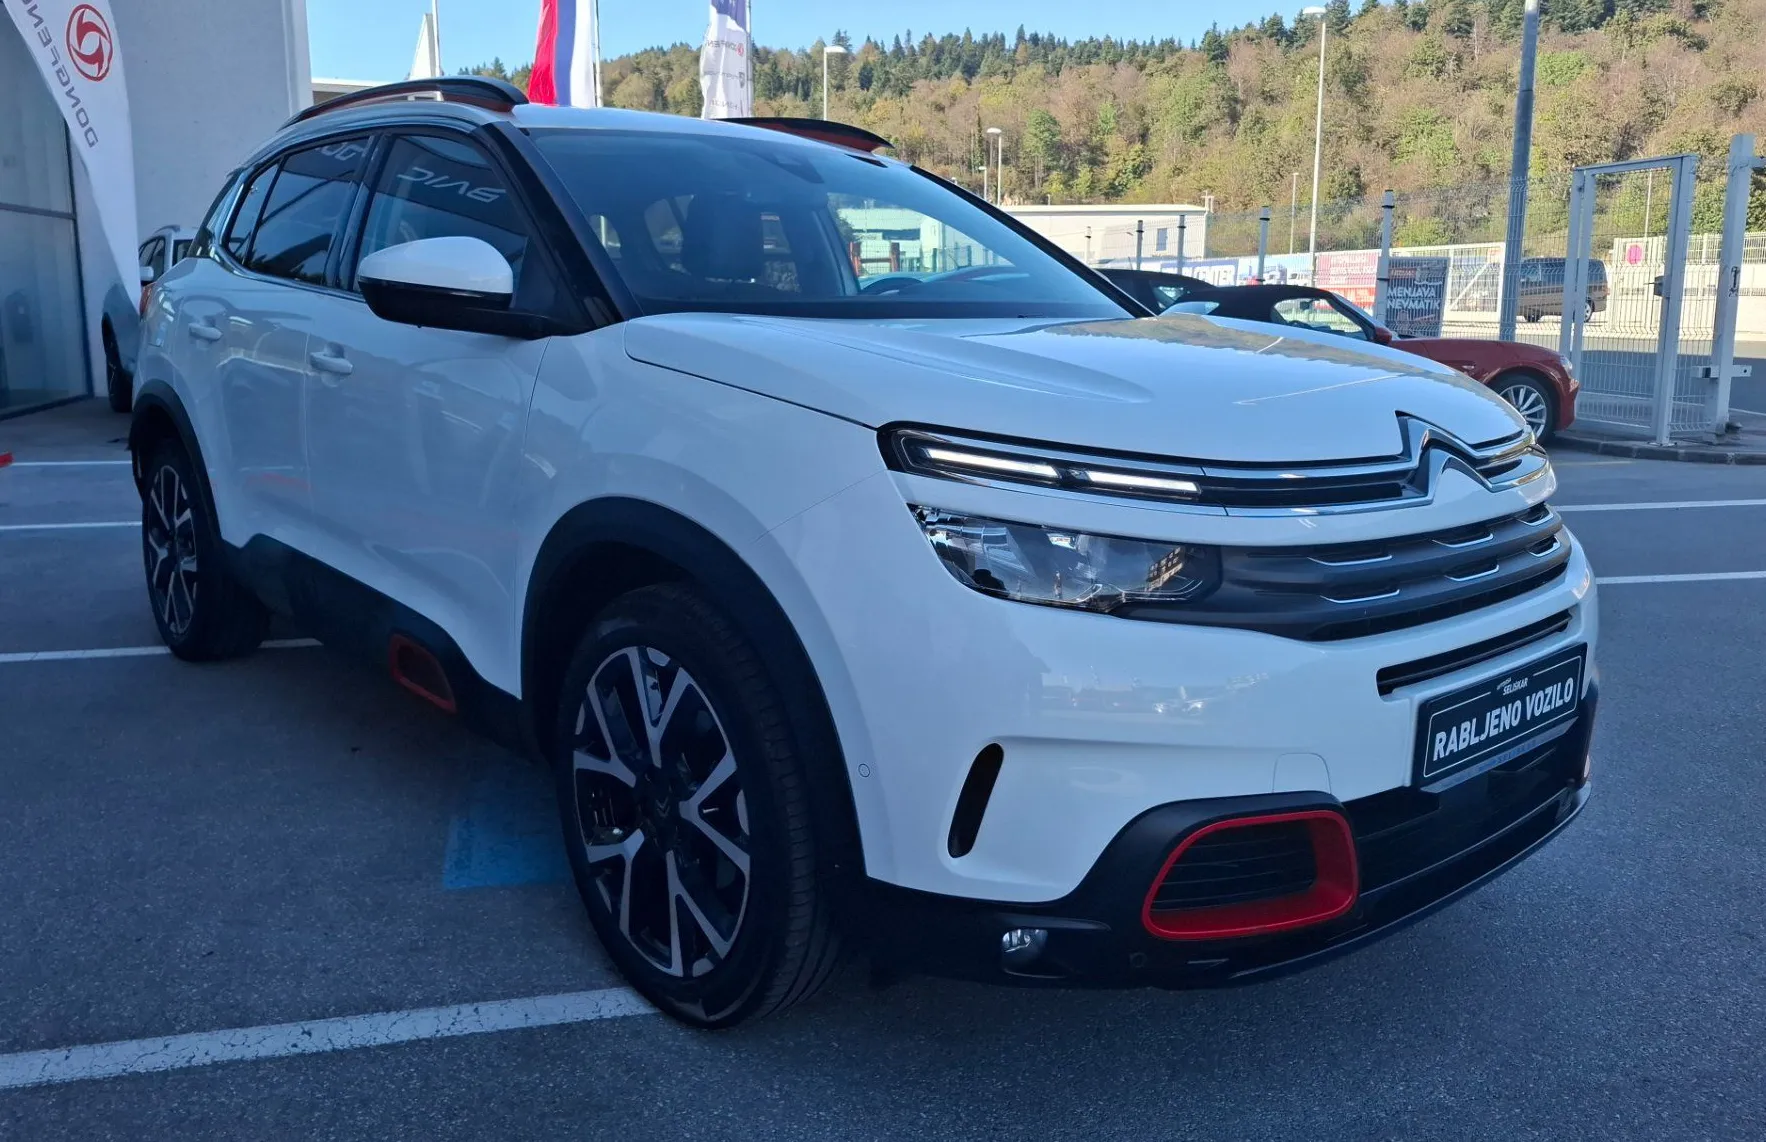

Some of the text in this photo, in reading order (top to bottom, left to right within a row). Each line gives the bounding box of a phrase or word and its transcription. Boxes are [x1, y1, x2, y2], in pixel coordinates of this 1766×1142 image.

[1387, 286, 1436, 298] MENJAVA
[1386, 299, 1440, 310] NEVMATIK
[1433, 677, 1574, 761] RABLJENO VOZILO
